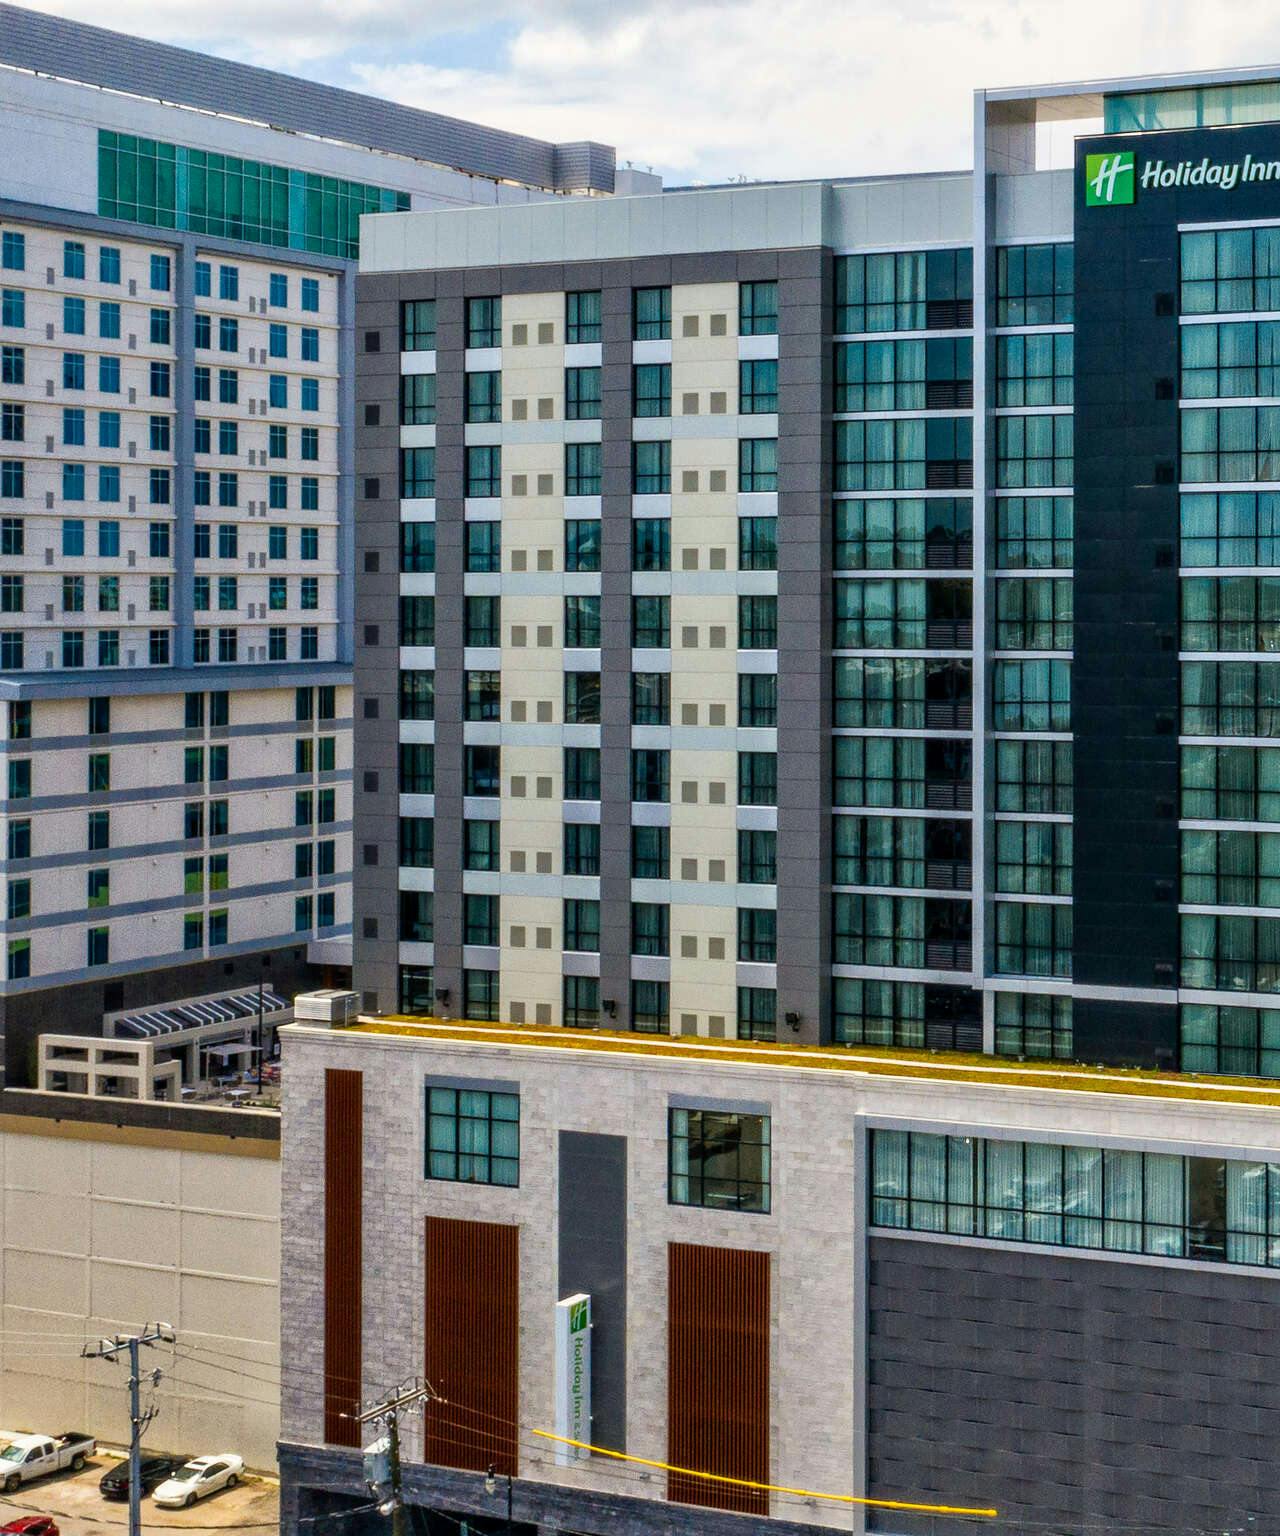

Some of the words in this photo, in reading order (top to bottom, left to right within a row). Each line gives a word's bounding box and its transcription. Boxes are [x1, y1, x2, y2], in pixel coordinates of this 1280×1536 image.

[1141, 158, 1238, 189] Holiday
[572, 1337, 584, 1394] Holiday
[574, 1396, 583, 1419] Inn
